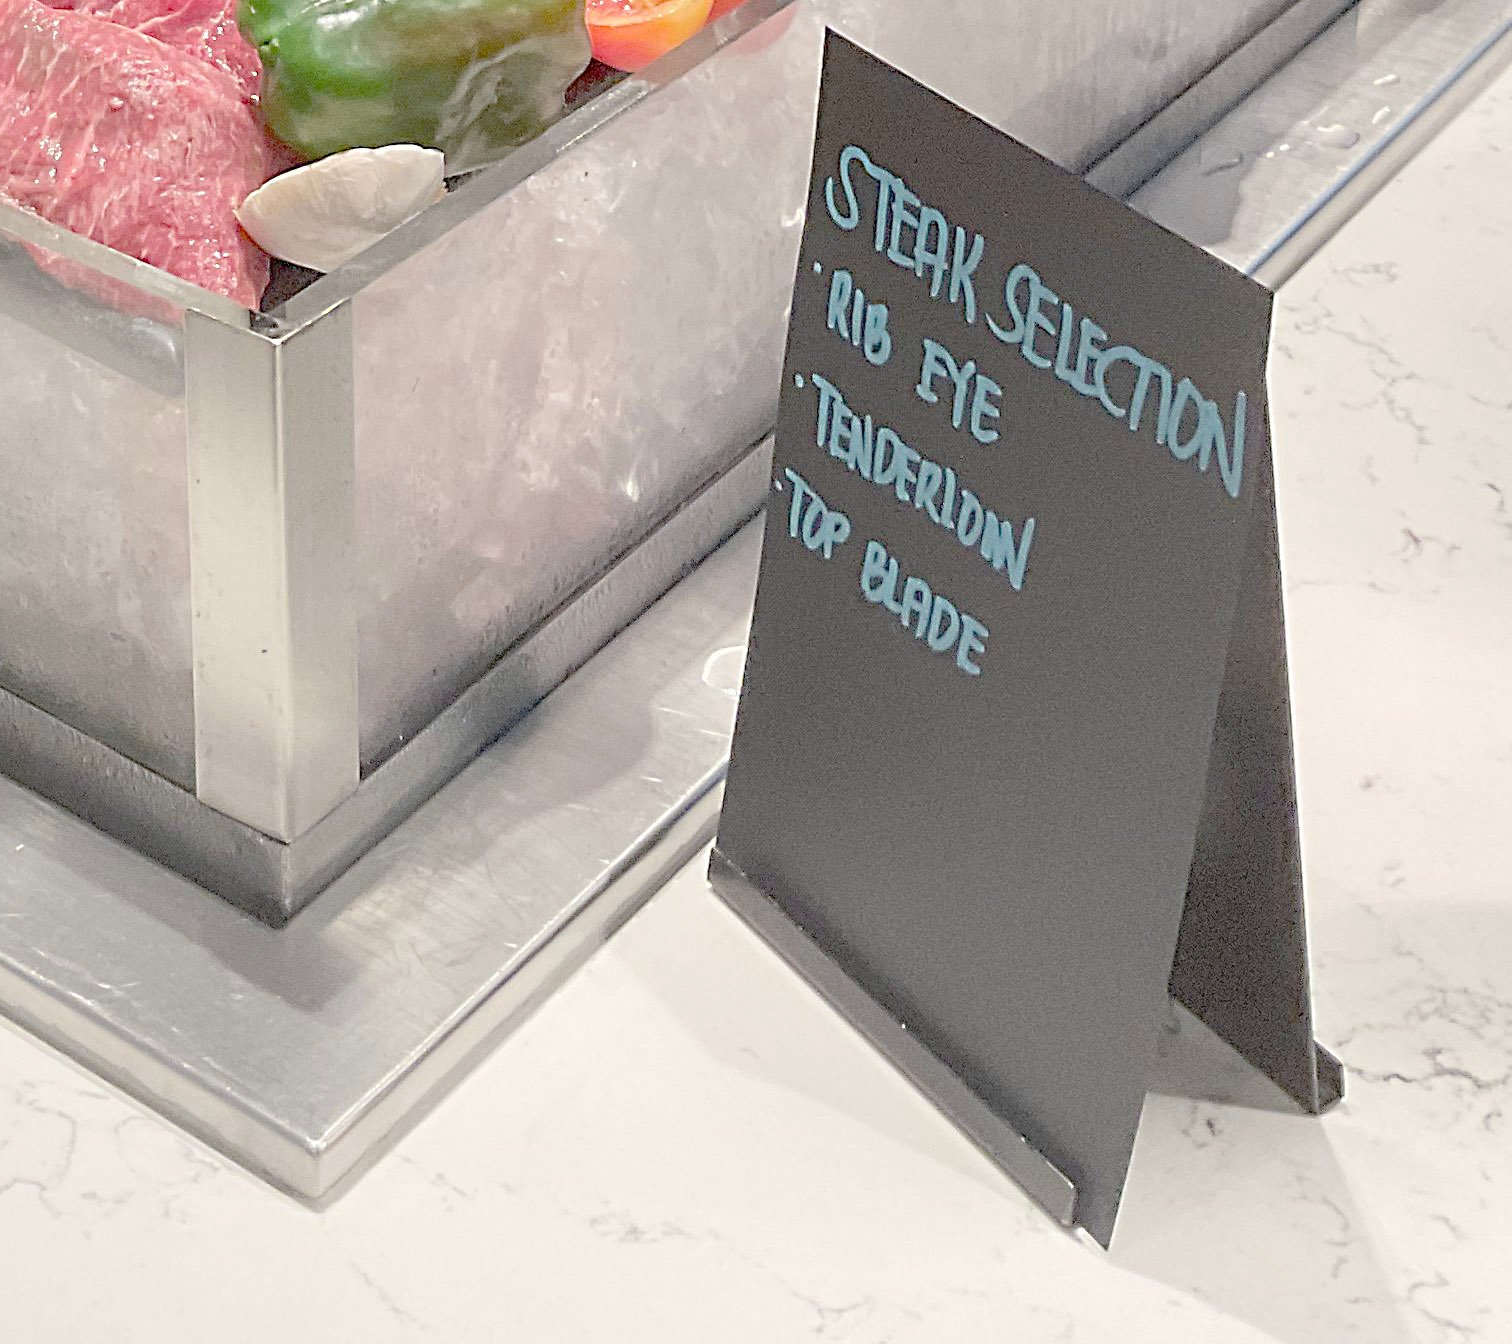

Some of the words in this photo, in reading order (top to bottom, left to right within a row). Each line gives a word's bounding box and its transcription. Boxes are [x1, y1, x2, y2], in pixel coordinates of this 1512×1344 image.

[824, 144, 985, 324] STEAK
[987, 263, 1246, 498] SELECTION
[828, 269, 893, 366] RIB
[916, 338, 1002, 444] EYE
[785, 467, 851, 560] TOP
[860, 540, 990, 675] BLADE
